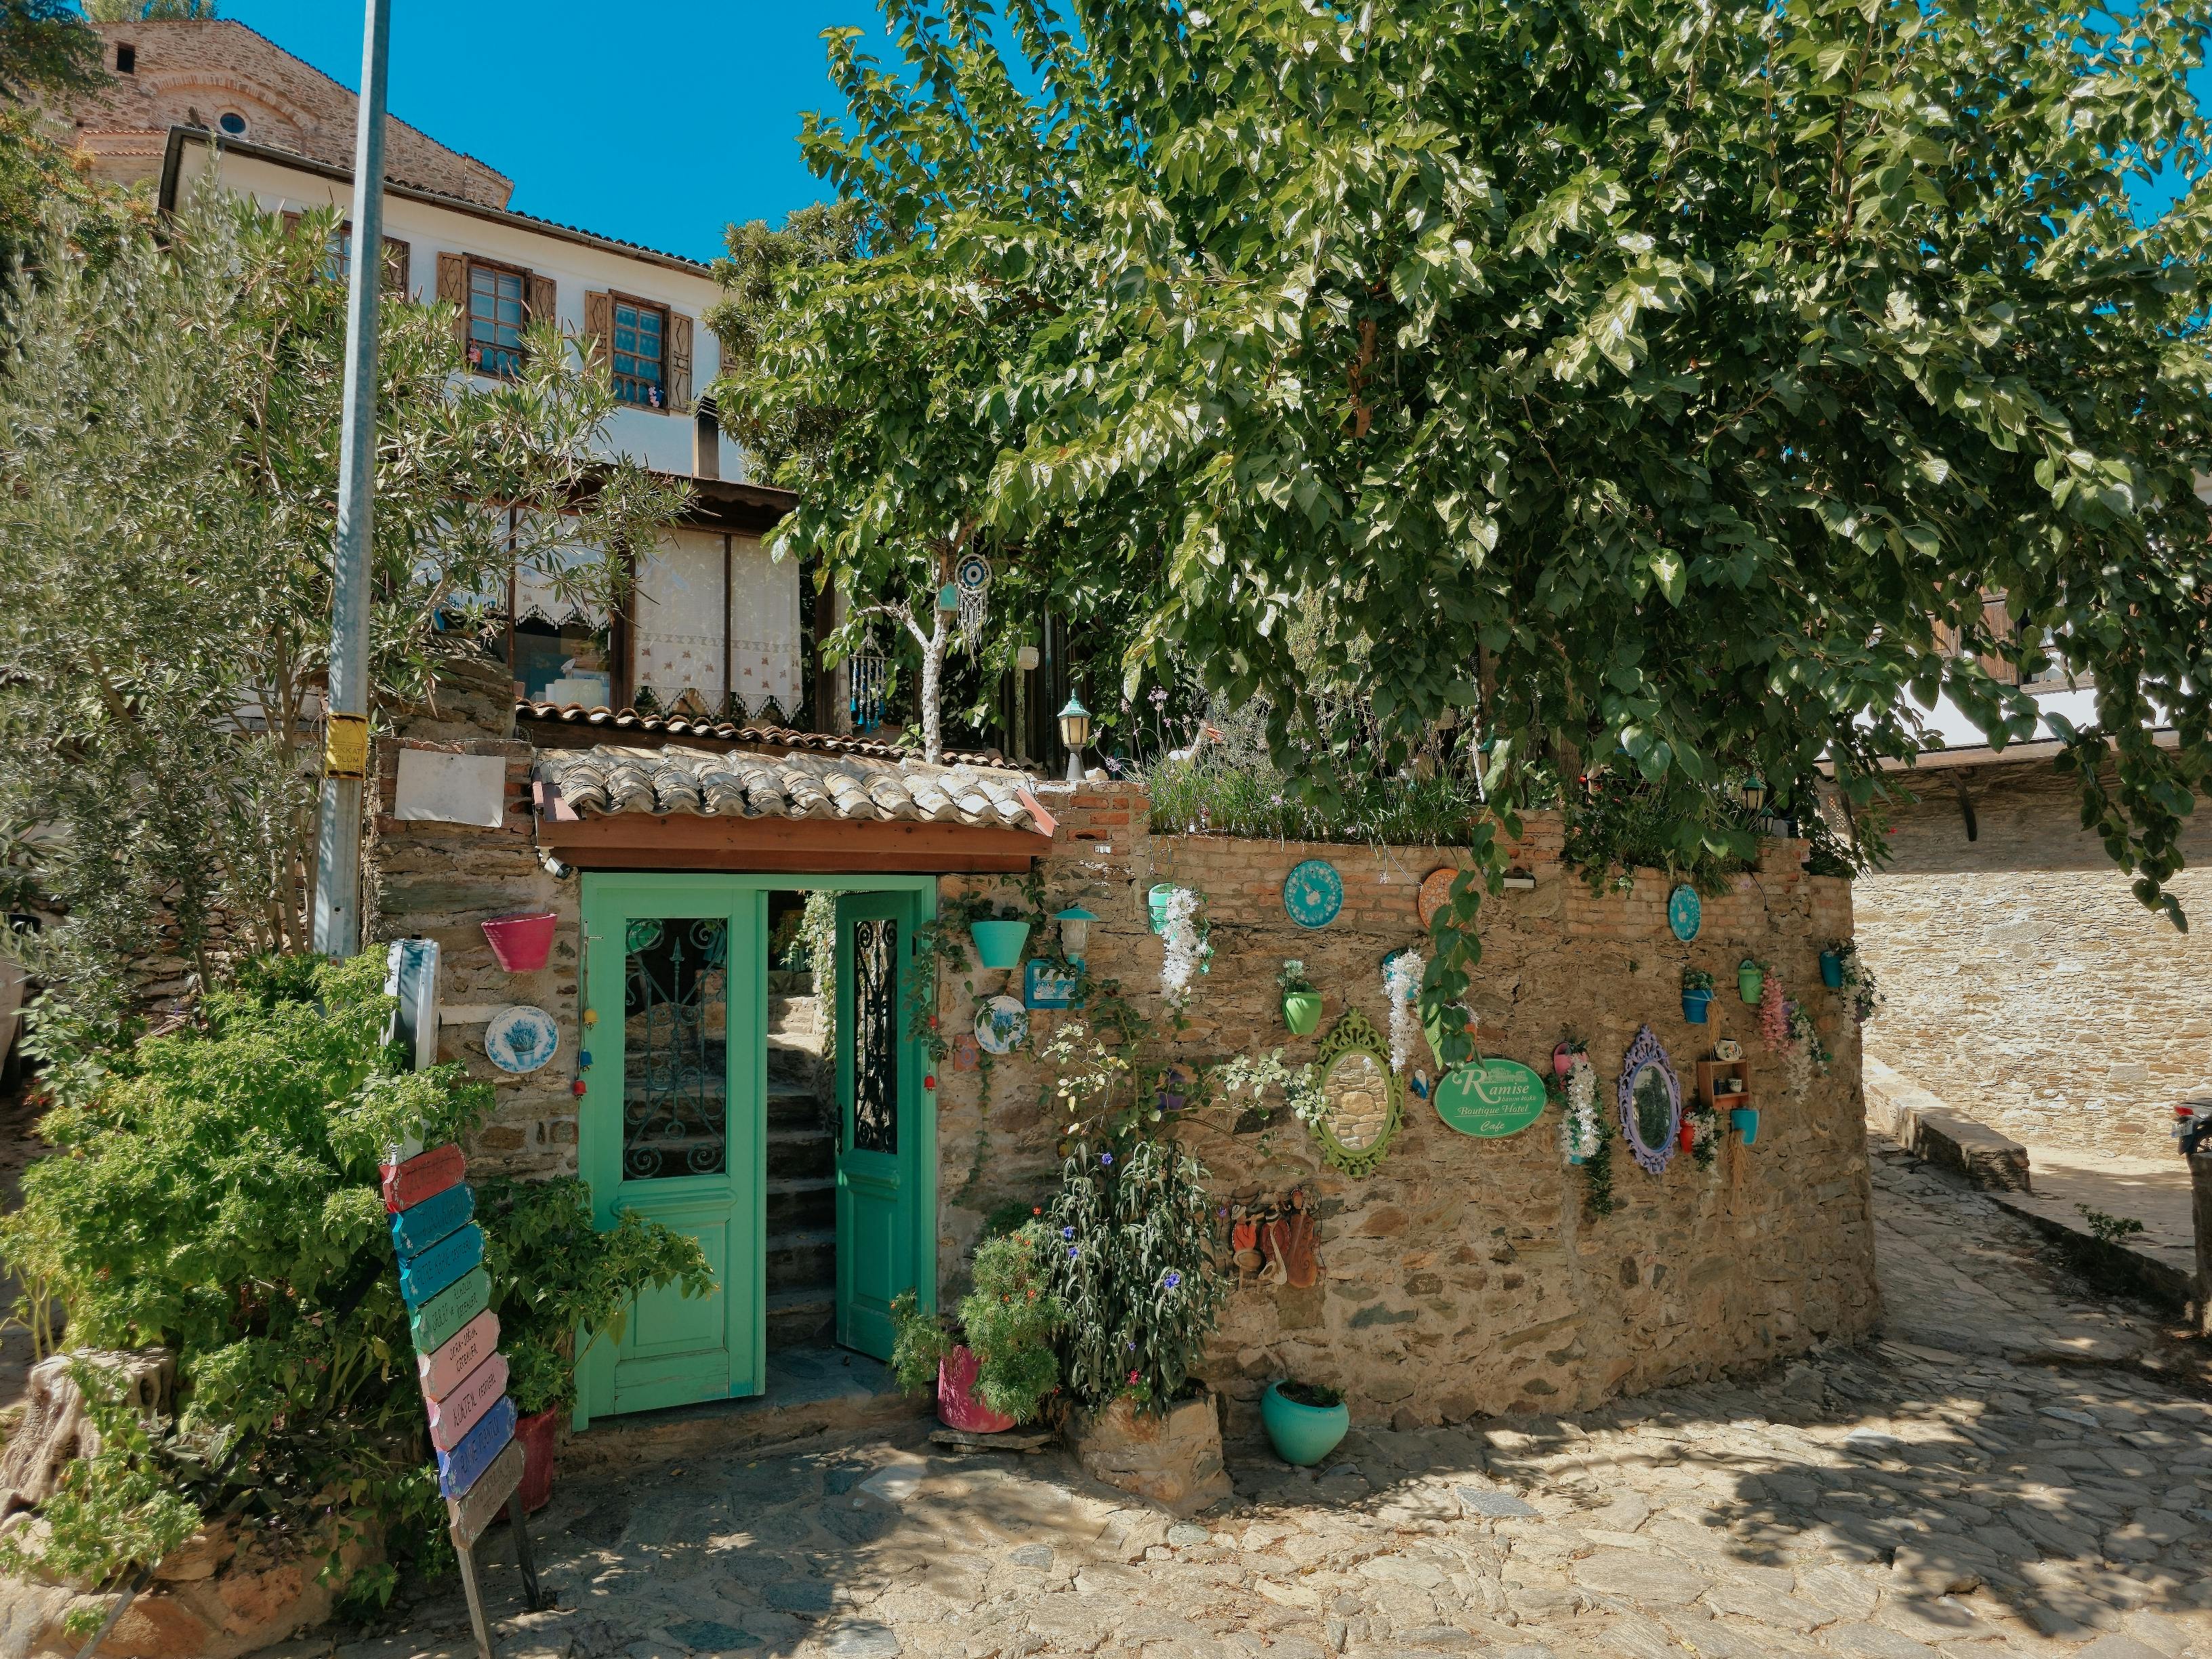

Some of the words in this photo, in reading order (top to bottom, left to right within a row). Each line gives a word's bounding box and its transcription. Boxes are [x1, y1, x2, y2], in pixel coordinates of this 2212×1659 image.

[1452, 1069, 1530, 1104] Ramise
[1457, 1106, 1500, 1116] Boutique
[1501, 1103, 1529, 1113] Hotel
[1479, 1120, 1504, 1132] Cafe
